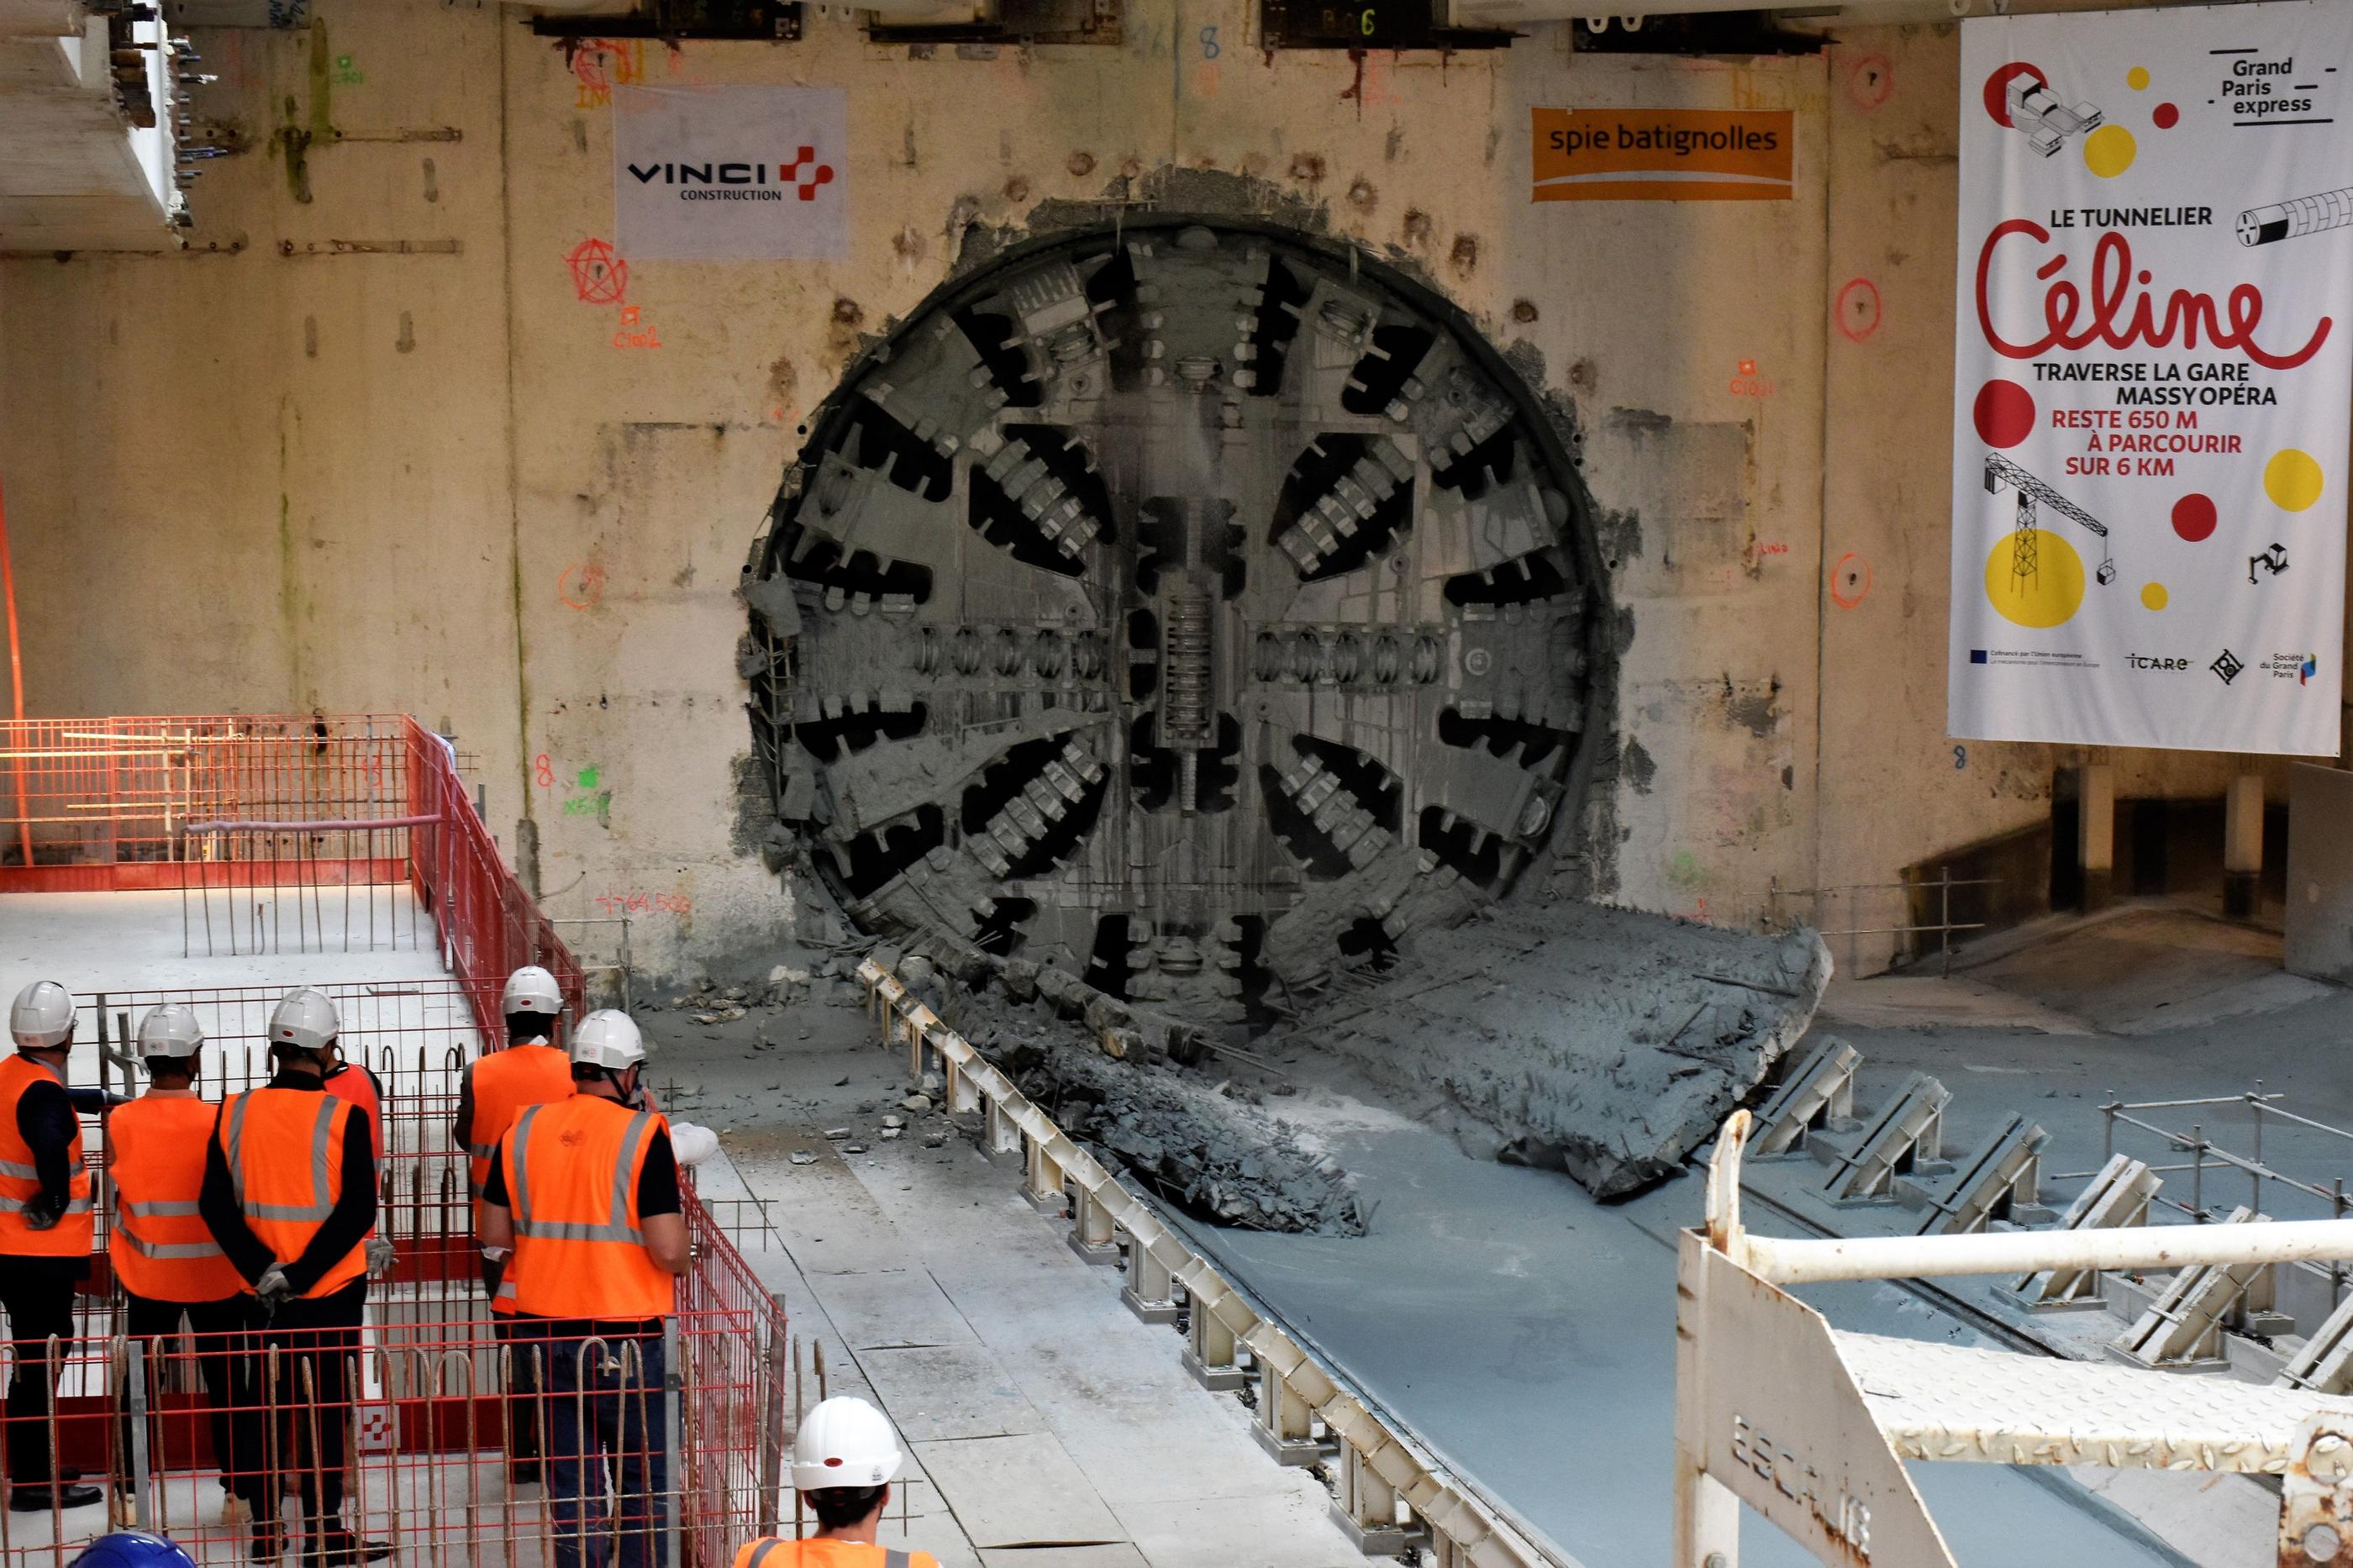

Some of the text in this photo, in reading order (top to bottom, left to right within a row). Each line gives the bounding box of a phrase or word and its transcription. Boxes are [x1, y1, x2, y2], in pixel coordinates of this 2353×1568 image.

[1199, 26, 1220, 60] 8
[2233, 57, 2292, 76] Grand
[2221, 80, 2271, 97] Paris
[2233, 97, 2312, 116] express
[1550, 124, 1778, 156] spie batignolles
[628, 163, 766, 184] VINCI
[680, 189, 782, 201] CONSTRUCTION
[2050, 207, 2213, 228] LE TUNNELIER
[1976, 218, 2333, 371] Céline
[2033, 363, 2250, 382] TRAVERSE LA GARE
[2052, 410, 2198, 429] RESTE 650 M
[2087, 430, 2243, 454] À PARCOURIR
[2066, 458, 2175, 476] SUR 6 KM
[2260, 661, 2298, 671] du Grand
[2273, 653, 2304, 662] Société
[2272, 671, 2294, 679] Paris
[1952, 745, 1966, 770] 8
[535, 753, 555, 787] 8
